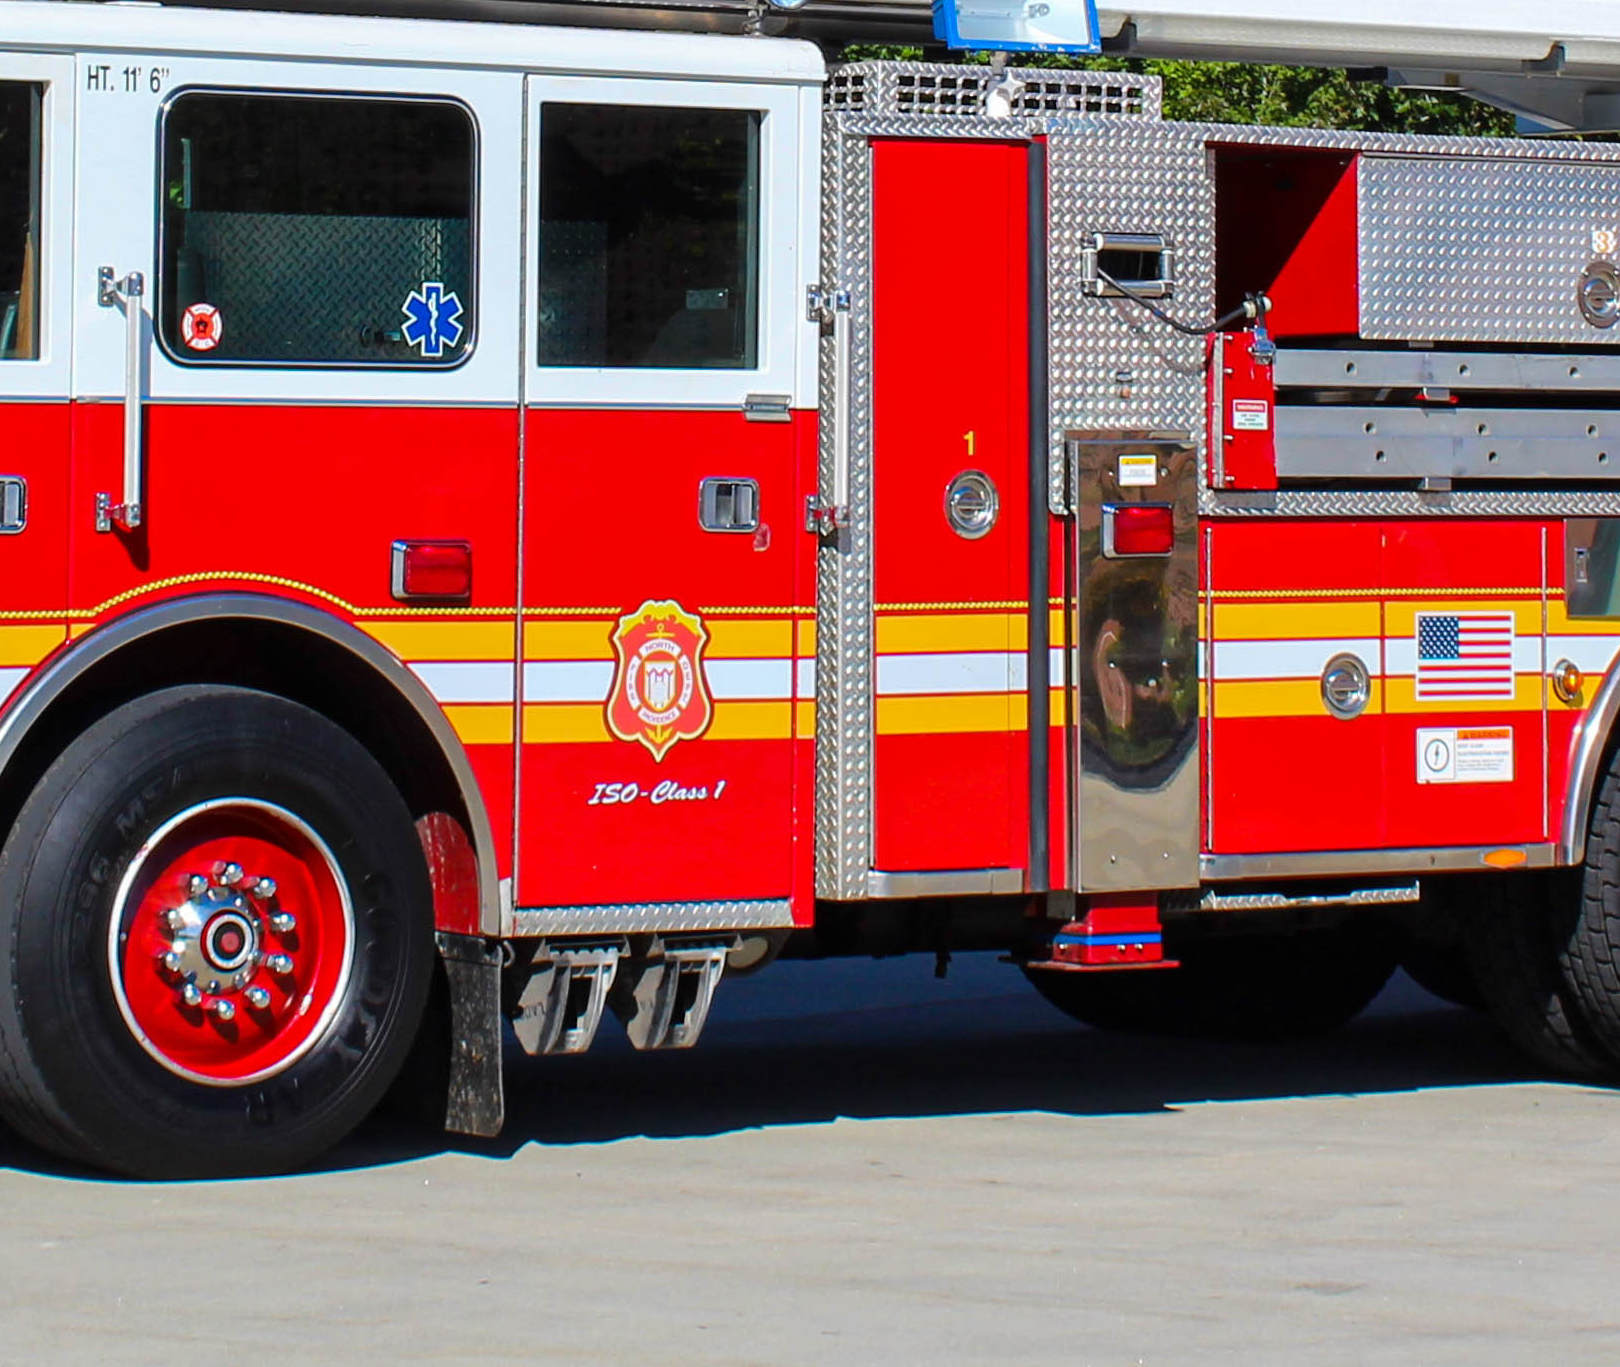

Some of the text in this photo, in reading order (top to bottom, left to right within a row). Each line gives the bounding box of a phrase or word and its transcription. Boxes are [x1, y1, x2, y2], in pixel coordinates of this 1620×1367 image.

[87, 65, 114, 91] HT.
[1596, 231, 1610, 253] 3
[963, 430, 975, 456] 1
[713, 780, 727, 800] 1
